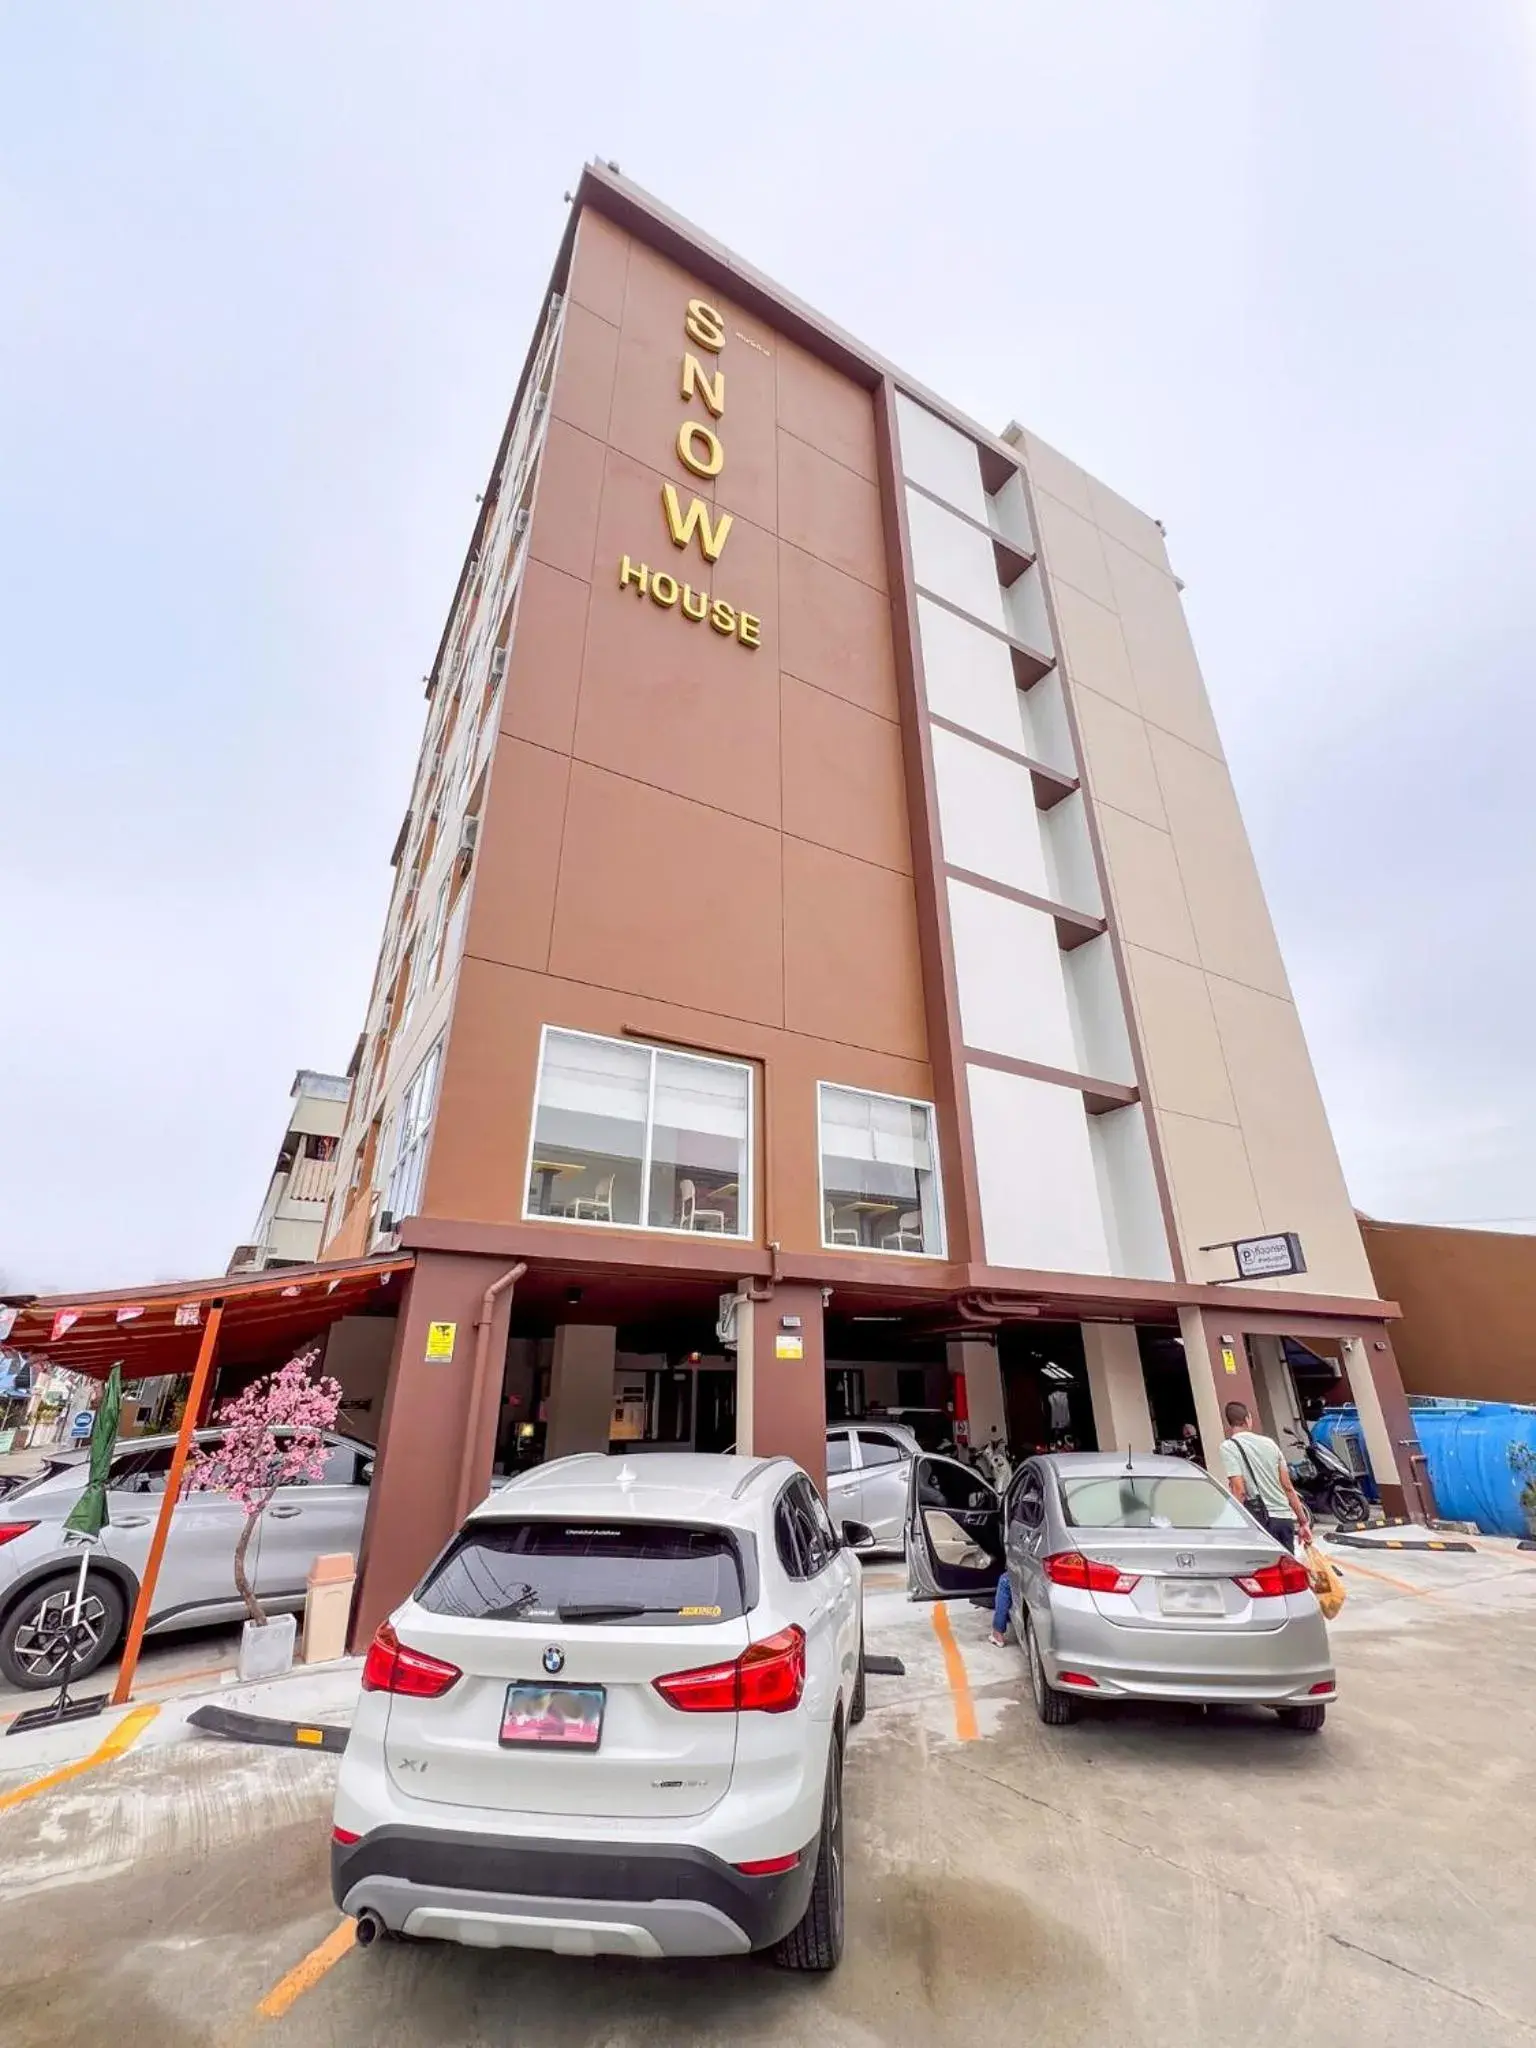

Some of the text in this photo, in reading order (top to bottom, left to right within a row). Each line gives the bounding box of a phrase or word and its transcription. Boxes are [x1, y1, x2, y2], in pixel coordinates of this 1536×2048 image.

[661, 298, 734, 565] SNOW
[619, 554, 761, 650] HOUSE
[1243, 1250, 1252, 1262] P
